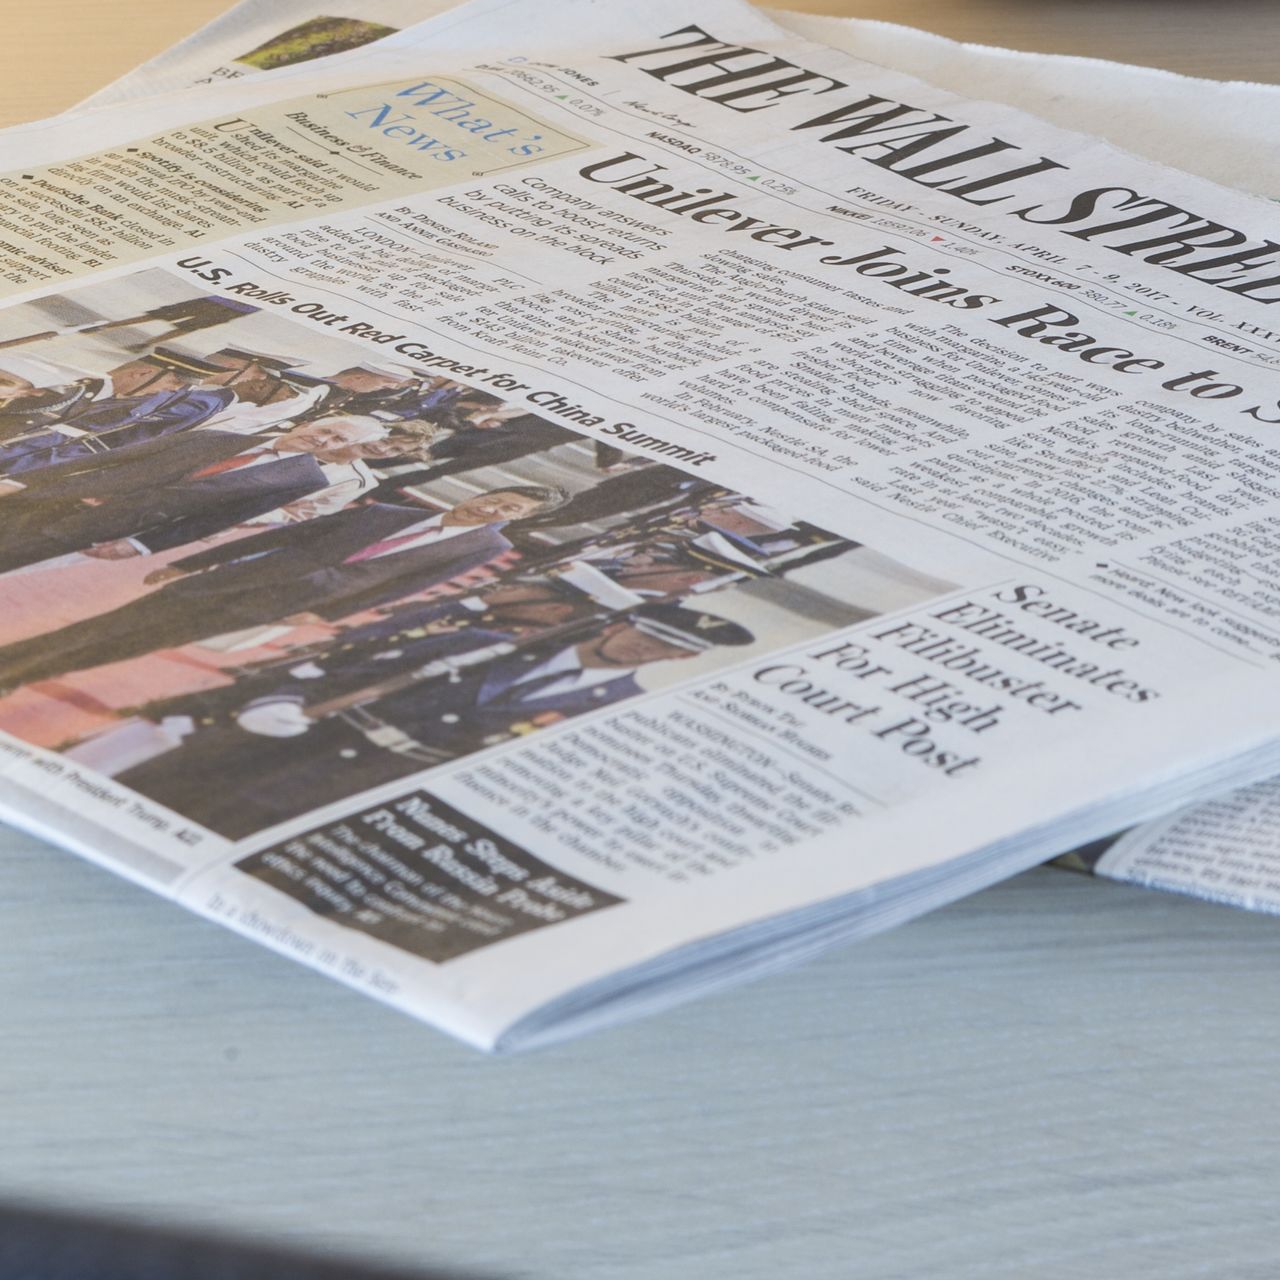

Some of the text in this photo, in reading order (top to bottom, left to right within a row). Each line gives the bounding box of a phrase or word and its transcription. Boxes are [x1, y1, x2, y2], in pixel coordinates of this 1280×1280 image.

[557, 68, 600, 87] JONES
[285, 111, 351, 147] Business
[359, 151, 423, 180] Finance
[347, 103, 468, 161] News
[397, 82, 542, 155] What's
[599, 25, 848, 113] THE
[790, 95, 1070, 206] WALL
[189, 126, 344, 203] unit, which could fetch up
[213, 118, 298, 154] Unilever
[294, 154, 329, 169] said
[335, 173, 381, 193] would
[230, 133, 344, 190] shed its margarine
[645, 131, 702, 155] NASDAQ
[760, 179, 797, 196] 0.25%
[436, 195, 615, 266] business on the block
[463, 189, 645, 260] by putting its spreads
[492, 184, 668, 251] calls to boost returns
[521, 177, 673, 236] Company answers
[825, 205, 874, 221] NIKKEI
[579, 152, 834, 250] Unilever
[820, 246, 1002, 309] Joins
[987, 303, 1164, 373] Race
[1161, 369, 1244, 400] to
[845, 186, 919, 212] FRIDAY
[1013, 243, 1067, 264] APRIL
[1123, 282, 1170, 301] 2017
[1186, 305, 1224, 323] VOL.
[1005, 265, 1057, 283] STOXX
[1078, 288, 1129, 309] 380.77
[176, 256, 717, 467] U.S. Rolls Out Red Carpet for China Summit
[1201, 335, 1255, 355] BRENT
[933, 602, 1158, 702] Eliminates
[994, 586, 1139, 648] Senate
[811, 641, 893, 680] For
[888, 673, 1004, 734] High
[873, 622, 1081, 714] Filibuster
[752, 664, 881, 724] Court
[873, 717, 980, 776] Post
